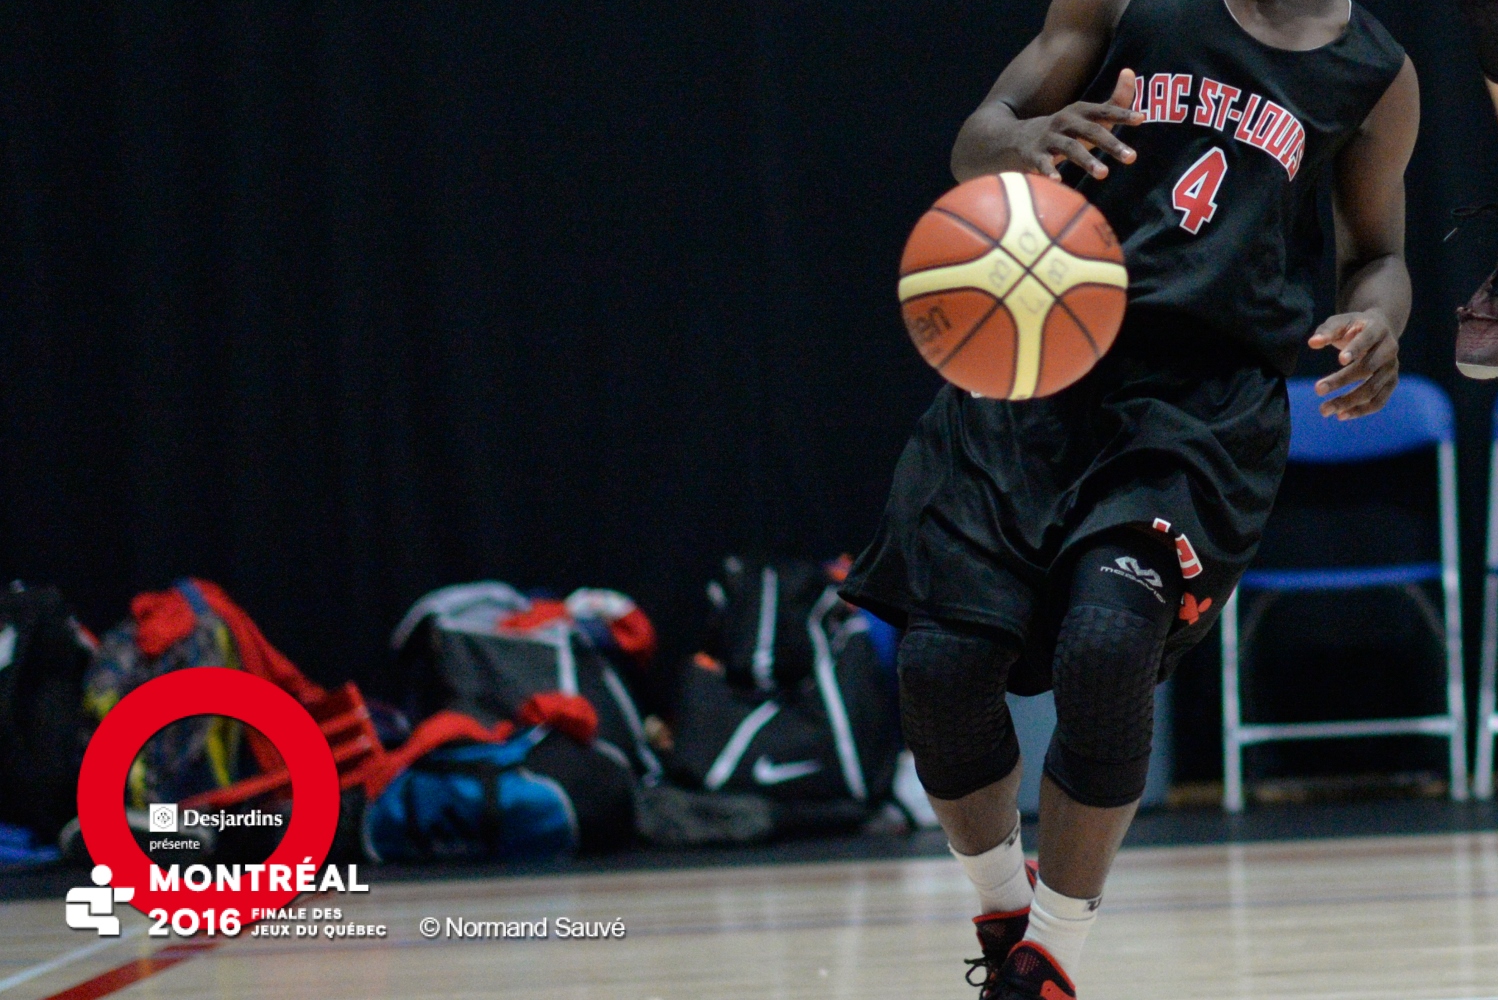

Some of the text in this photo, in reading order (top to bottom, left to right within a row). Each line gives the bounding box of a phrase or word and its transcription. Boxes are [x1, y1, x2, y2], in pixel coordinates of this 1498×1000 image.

[1132, 72, 1306, 182] LAC ST-LOUIS
[1172, 146, 1228, 235] 4
